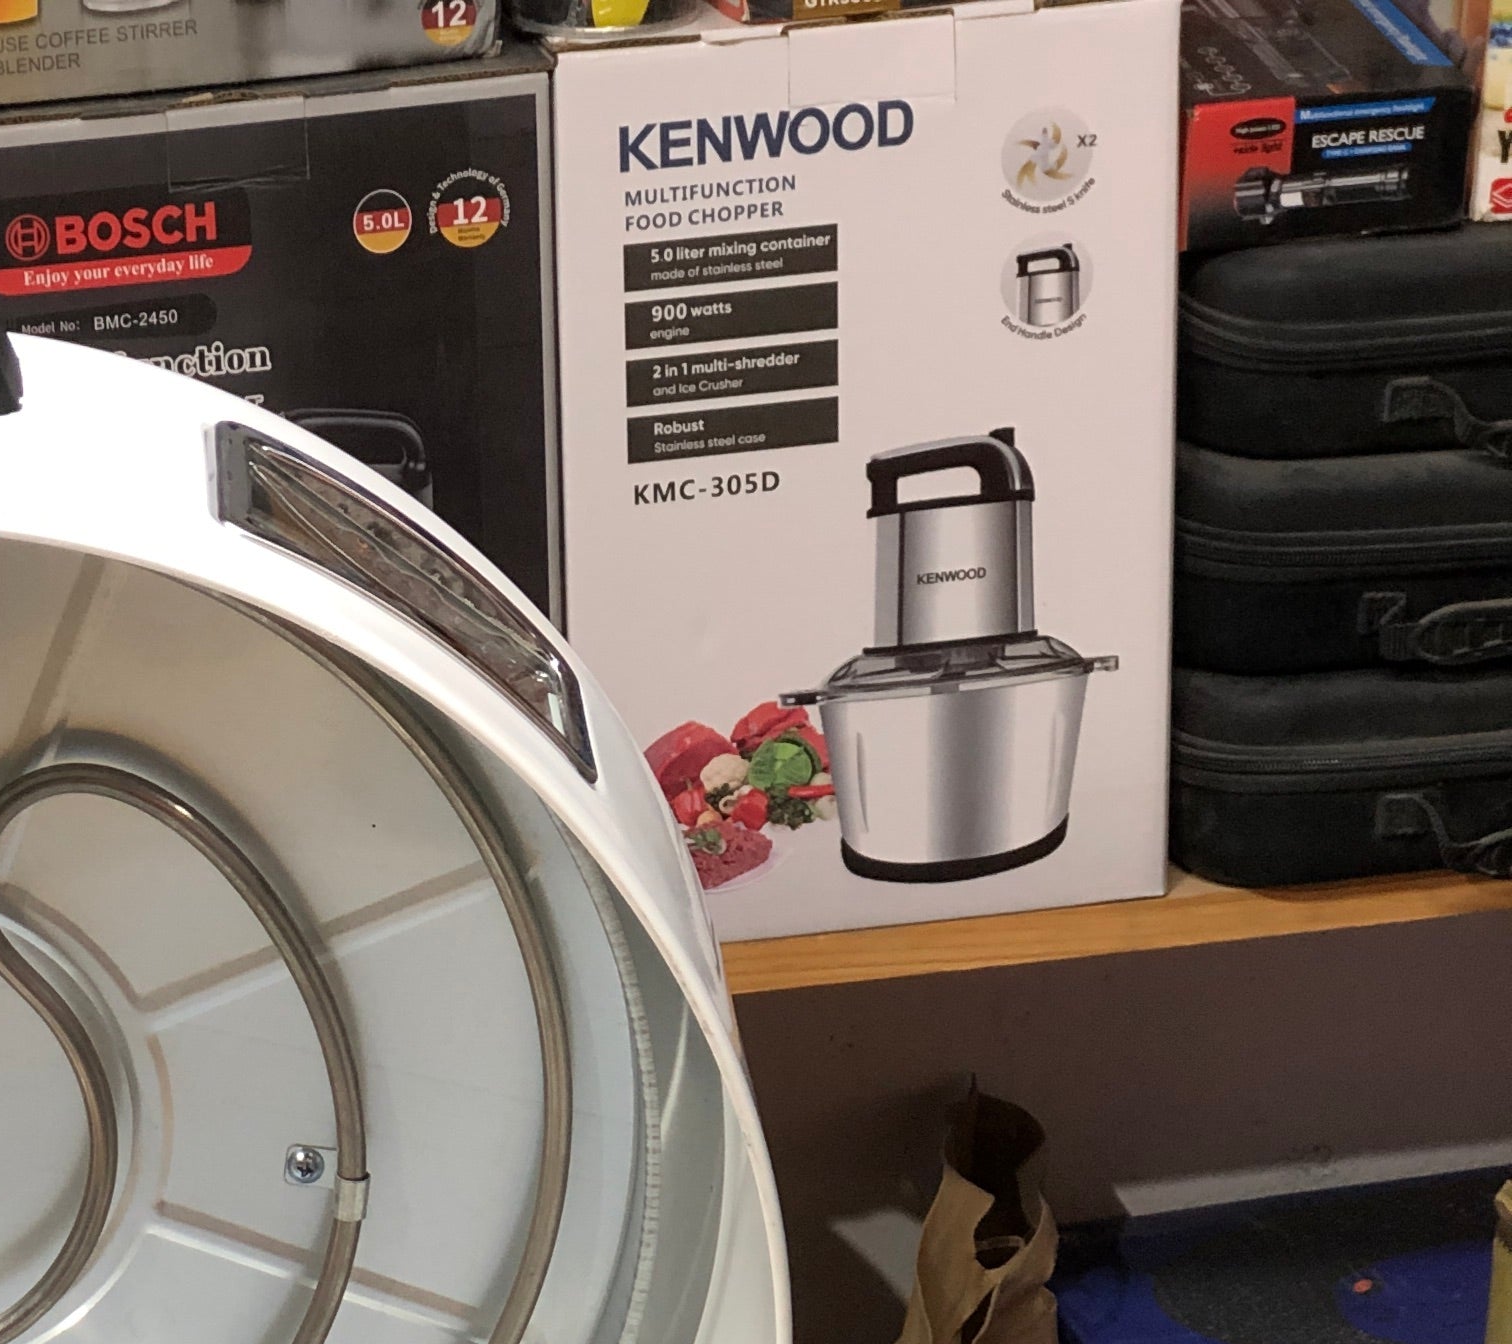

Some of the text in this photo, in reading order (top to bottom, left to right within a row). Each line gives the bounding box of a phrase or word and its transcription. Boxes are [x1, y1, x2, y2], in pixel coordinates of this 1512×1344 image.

[431, 0, 467, 27] 12
[35, 26, 110, 50] COFFEE
[117, 19, 198, 42] STIRRER
[619, 99, 914, 173] KENWOOD
[1311, 126, 1425, 149] ESCAPE RESCUE
[437, 168, 489, 191] Technology
[488, 175, 500, 186] of
[496, 183, 511, 228] Germany
[624, 174, 797, 207] MULTIFUNCTION
[1001, 188, 1041, 214] Stainless
[1041, 201, 1067, 214] steel
[1075, 177, 1097, 202] knife
[363, 212, 405, 231] 5.0L
[453, 196, 488, 226] 12
[625, 201, 784, 232] FOOD CHOPPER
[55, 201, 217, 255] BOSCH
[650, 234, 832, 264] 5.0 liter mixing container
[23, 253, 214, 287] Enjoy your everyday life
[650, 257, 783, 281] made of stainless steel
[21, 309, 179, 335] Model No: BMC-2450
[651, 301, 733, 322] 900 watts
[650, 326, 690, 341] engine
[1016, 326, 1053, 341] Handle
[1054, 312, 1088, 338] Design
[652, 352, 801, 379] 2 in 1 multi-shredder
[653, 378, 744, 397] and Ice Crusher
[653, 419, 705, 436] Robust
[653, 433, 767, 454] Stainless steel case
[633, 471, 781, 505] KMC-305D
[916, 566, 987, 586] KENWOOD
